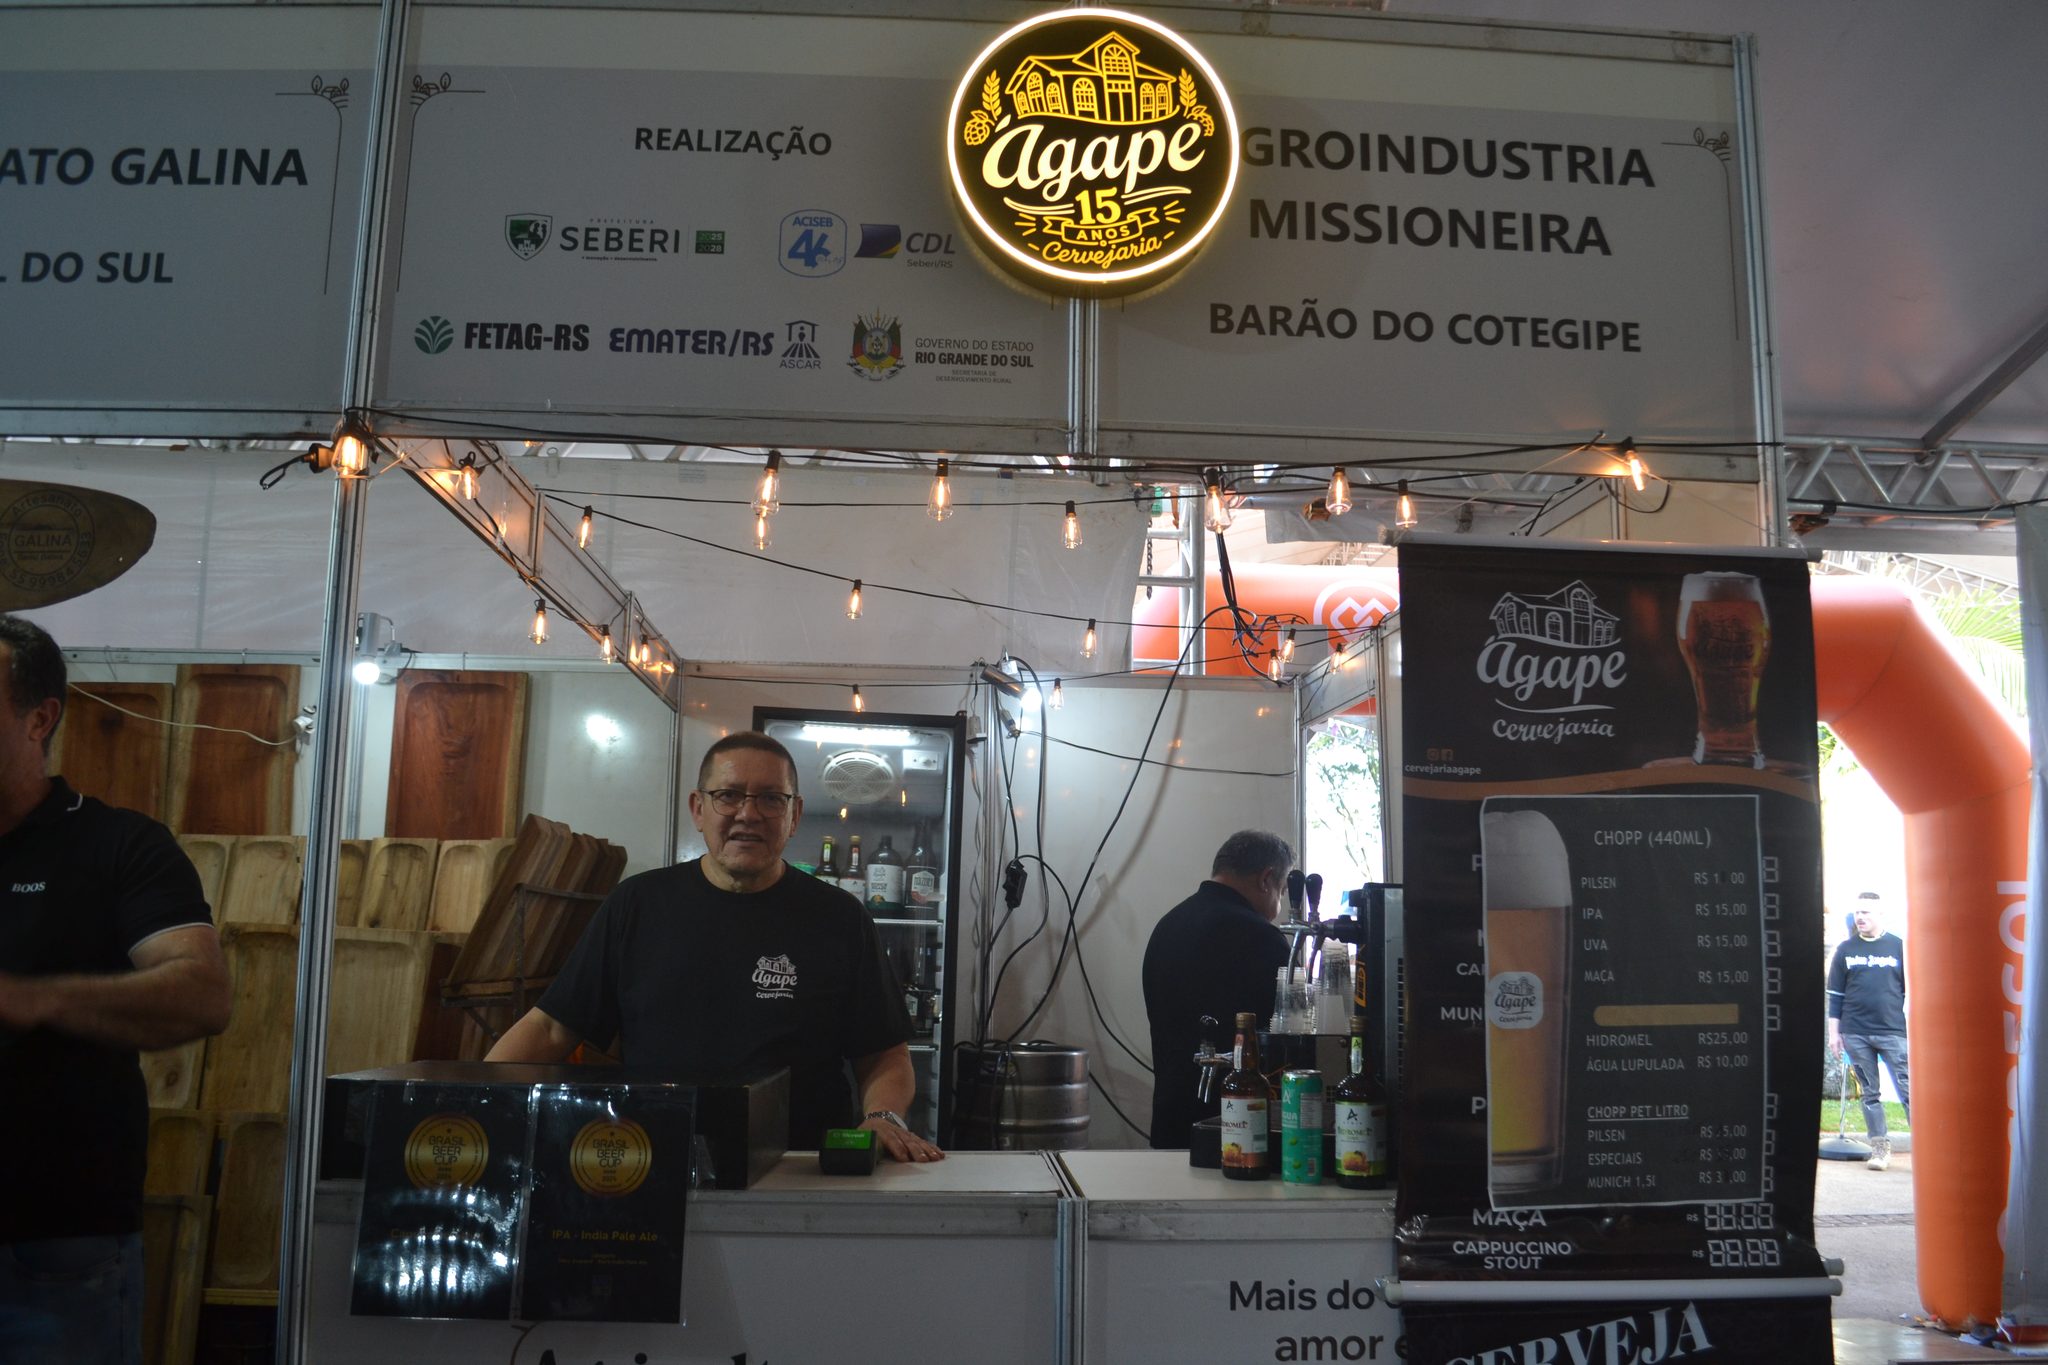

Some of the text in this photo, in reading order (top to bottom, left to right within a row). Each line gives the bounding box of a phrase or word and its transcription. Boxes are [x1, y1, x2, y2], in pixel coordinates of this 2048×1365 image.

[635, 126, 832, 161] REALIZAÇÃO
[1241, 128, 1656, 187] GROINDUSTRIA
[111, 148, 308, 186] GALINA
[1075, 187, 1121, 225] 15
[792, 216, 833, 228] ACISEB
[1249, 198, 1613, 256] MISSIONEIRA
[560, 226, 681, 254] SEBERI
[1076, 226, 1130, 240] ANOS
[906, 232, 956, 254] CDL
[1042, 235, 1161, 269] Cervejaria
[21, 252, 173, 283] DO SUL
[907, 259, 953, 269] Seberi/RS
[1209, 298, 1642, 353] BARÃO DO COTEGIPE
[464, 322, 590, 352] FETAG-RS
[609, 327, 775, 357] EMATER/RS
[915, 338, 1034, 352] GOVERNO DO ESTADO
[779, 360, 822, 369] ASCAR
[915, 351, 1034, 368] RIO GRANDE DO SUL
[14, 534, 72, 547] GALINA
[1493, 716, 1615, 745] Cervejaria
[1404, 763, 1481, 776] cervejariaagape
[1594, 827, 1711, 849] CHOPP (440ML)
[1581, 876, 1617, 889] PILSEN
[1582, 907, 1603, 920] IPA
[1583, 938, 1608, 951] UVA
[1586, 1034, 1653, 1047] HIDROMEL
[1621, 1057, 1685, 1071] LUPULADA
[1587, 1104, 1689, 1119] CHOPP PET LITRO
[1587, 1129, 1626, 1142] PILSEN
[432, 1145, 462, 1156] BEER
[596, 1149, 625, 1158] BEER
[434, 1155, 458, 1165] CUP
[599, 1158, 622, 1168] CUP
[1587, 1152, 1643, 1166] ESPECIAIS
[1587, 1175, 1631, 1189] MUNICH
[552, 1229, 571, 1240] IPA
[581, 1229, 609, 1241] India
[611, 1230, 637, 1241] Pale
[638, 1231, 658, 1242] Ale
[1452, 1240, 1572, 1256] CAPPUCCINO
[1483, 1255, 1542, 1270] STOUT
[1230, 1279, 1375, 1312] Mais do
[1275, 1334, 1385, 1362] amor
